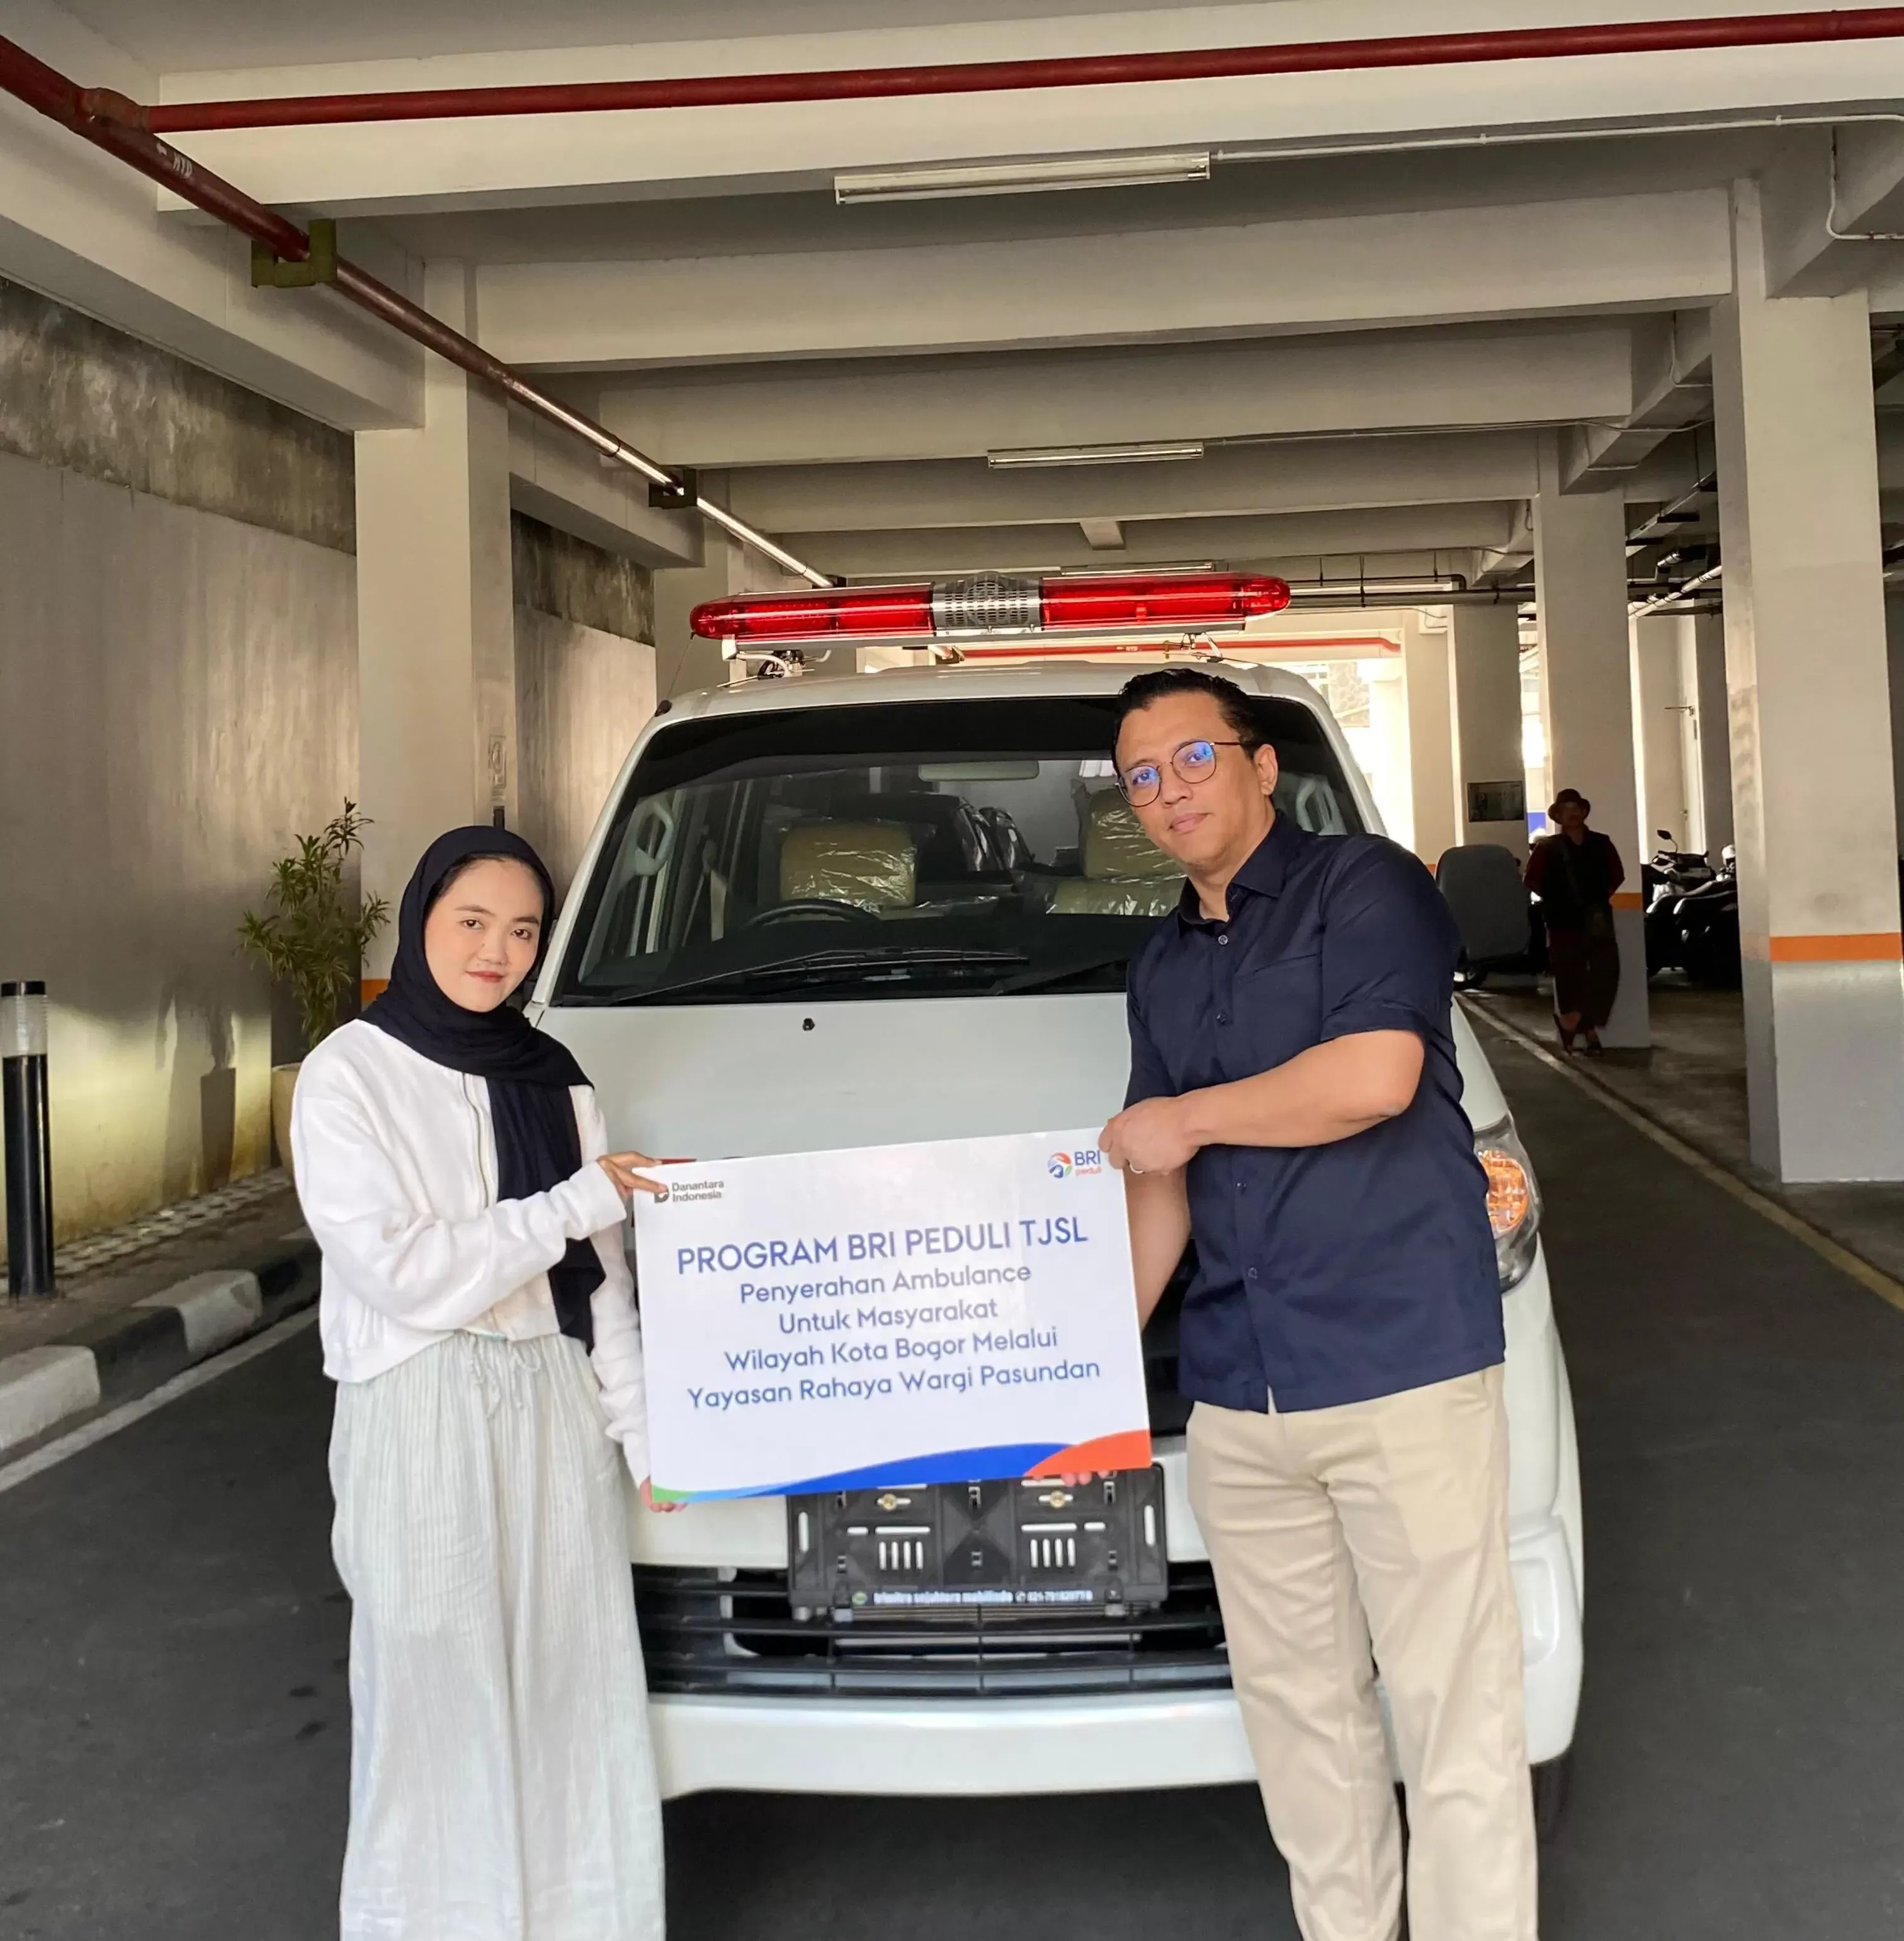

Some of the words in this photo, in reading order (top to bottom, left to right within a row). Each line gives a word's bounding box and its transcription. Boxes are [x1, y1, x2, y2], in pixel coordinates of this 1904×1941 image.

[1074, 1149, 1101, 1166] BRI
[671, 1181, 724, 1192] Danantara
[672, 1190, 722, 1202] Indonesia
[677, 1236, 838, 1275] PROGRAM
[847, 1231, 895, 1260] BRI
[905, 1222, 1011, 1256] PEDULI
[1019, 1217, 1089, 1246] TJSL
[740, 1275, 885, 1304] Penyerahan
[892, 1265, 1031, 1292] Ambulance
[779, 1309, 851, 1333] Untuk
[857, 1299, 999, 1329] Masyarakat
[725, 1345, 824, 1372] Wilayah
[831, 1342, 888, 1363] Kota
[895, 1337, 966, 1361] Bogor
[972, 1326, 1058, 1353] Melalui
[688, 1386, 791, 1411] Yayasan
[800, 1377, 892, 1399] Rahaya
[898, 1367, 973, 1393] Wargi
[980, 1359, 1100, 1386] Pasundan
